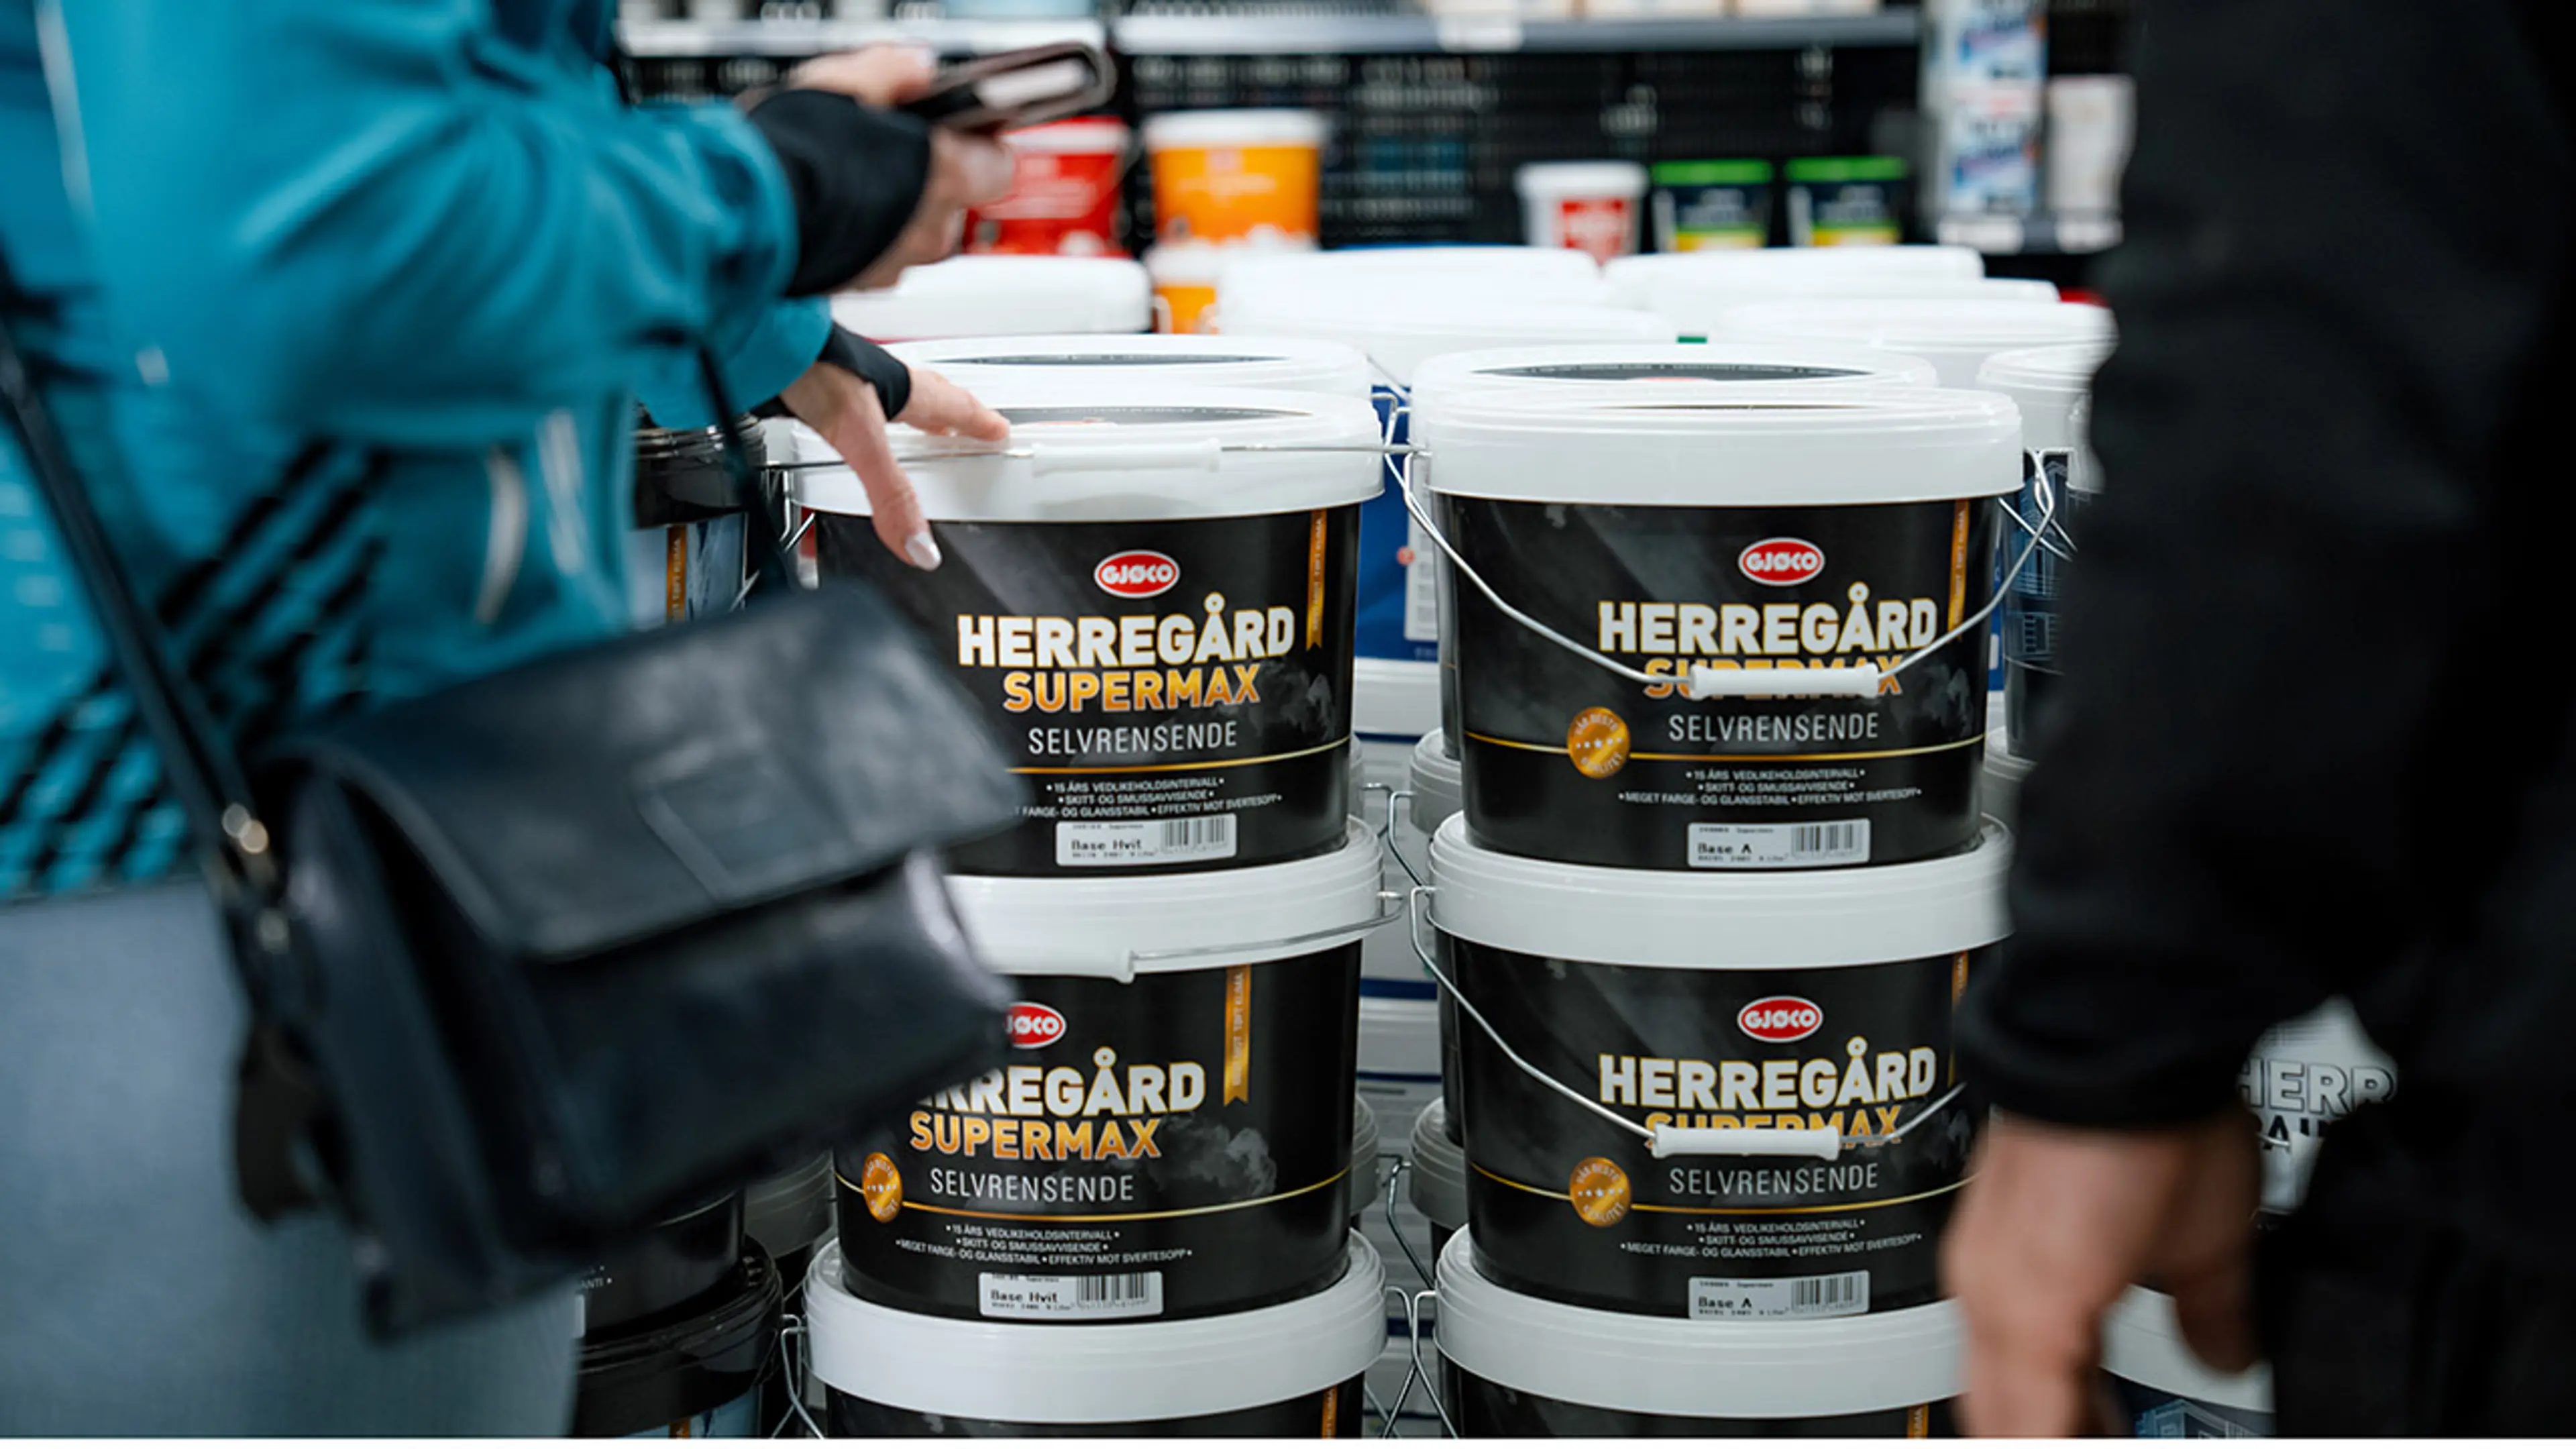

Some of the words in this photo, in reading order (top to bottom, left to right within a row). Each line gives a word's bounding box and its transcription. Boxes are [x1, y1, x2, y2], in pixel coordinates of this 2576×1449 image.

[1746, 552, 1817, 572] GJØCO
[1099, 564, 1173, 584] GJØCO
[1597, 582, 1937, 654] HERREGÅRD
[957, 592, 1294, 667] HERREGÅRD
[1004, 663, 1260, 712] SUPERMAX
[1669, 712, 1879, 742] SELVRENSENDE
[1028, 721, 1237, 755] SELVRENSENDE
[1707, 768, 1729, 780] ÅRS
[1067, 780, 1089, 793] ÅRS
[1092, 776, 1218, 793] VEDLIKEHOLDSINTERVALL
[1737, 782, 1756, 793] OG
[1097, 794, 1115, 804] OG
[1117, 790, 1207, 804] SMUSSAVVISENDE
[1624, 791, 1660, 804] MEGET
[1701, 794, 1718, 804] OG
[1844, 791, 1865, 803] MOT
[1061, 806, 1078, 817] OG
[1080, 806, 1150, 818] GLANSSTABIL
[1157, 803, 1201, 815] EFFEKTIV
[1203, 800, 1224, 812] MOT
[1071, 839, 1106, 851] Base
[1112, 839, 1142, 851] Hvit
[1698, 842, 1733, 855] Base
[1741, 843, 1752, 854] A
[1744, 1009, 1816, 1029] GJØCO
[1599, 1036, 1937, 1110] HERREGÅRD
[910, 1110, 1162, 1161] SUPERMAX
[930, 1169, 1134, 1201] SELVRENSENDE
[1670, 1163, 1878, 1195] SELVRENSENDE
[964, 1223, 983, 1236] ÅRS
[985, 1228, 1113, 1241] VEDLIKEHOLDSINTERVALL
[1707, 1221, 1730, 1233] ÅRS
[990, 1240, 1006, 1251] OG
[1008, 1241, 1102, 1253] SMUSSAVVISENDE
[1739, 1234, 1756, 1245] OG
[958, 1248, 973, 1260] OG
[1049, 1254, 1095, 1265] EFFEKTIV
[1097, 1253, 1120, 1264] MOT
[1122, 1248, 1187, 1264] SVERTESOPP
[1627, 1242, 1661, 1254] MEGET
[1702, 1247, 1719, 1257] OG
[1720, 1247, 1790, 1258] GLANSSTABIL
[1799, 1245, 1841, 1256] EFFEKTIV
[1844, 1241, 1865, 1253] MOT
[990, 1289, 1023, 1302] Base
[1029, 1291, 1057, 1303] Hvit
[1698, 1296, 1734, 1309] Base
[1741, 1297, 1753, 1308] A
